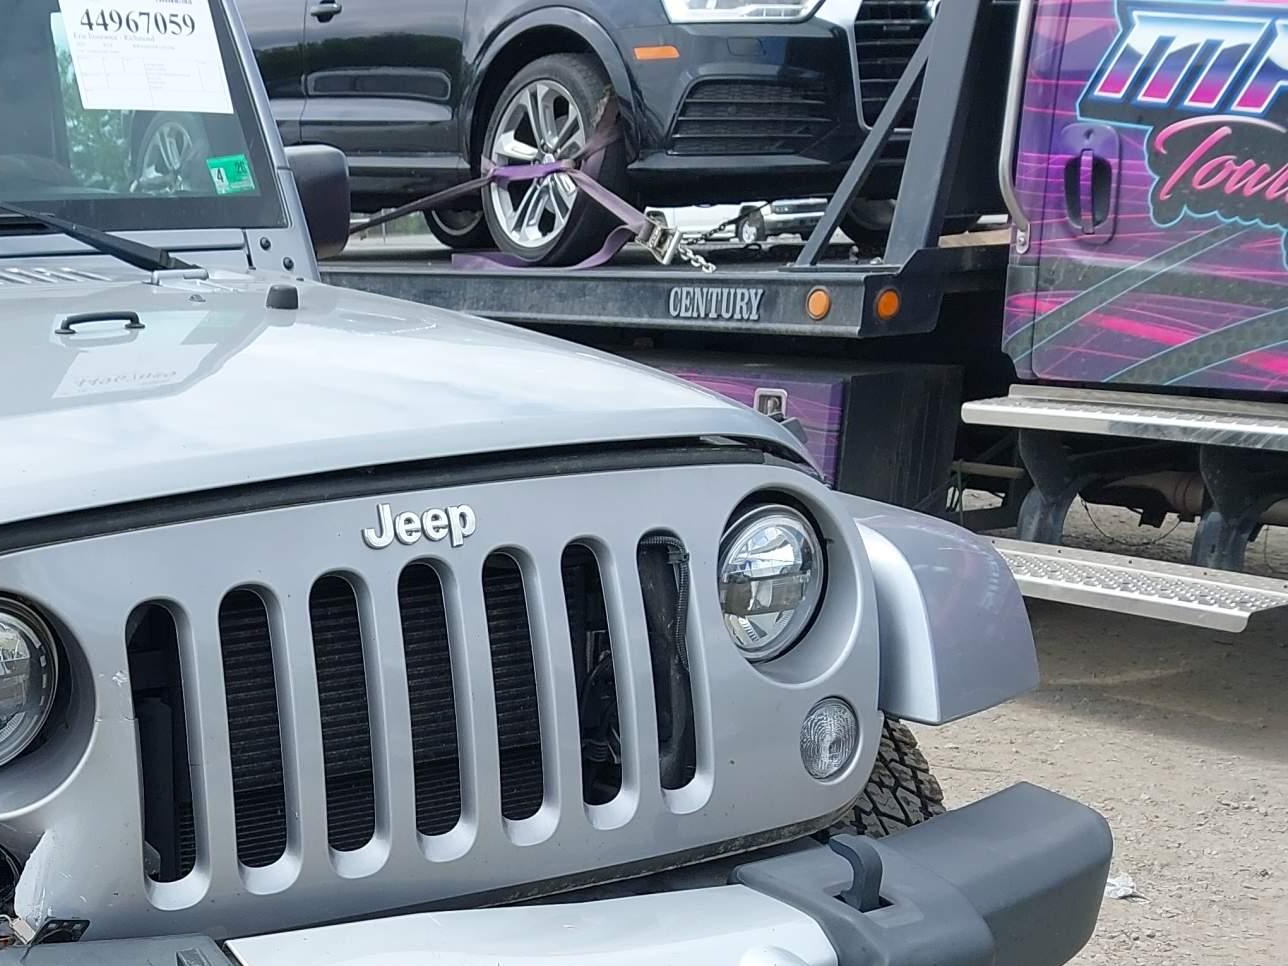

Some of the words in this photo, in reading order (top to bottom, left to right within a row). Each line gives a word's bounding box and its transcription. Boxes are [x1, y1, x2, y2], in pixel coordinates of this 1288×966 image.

[80, 8, 195, 36] 44967059
[668, 286, 764, 321] CENTURY
[362, 503, 476, 549] Jeep
